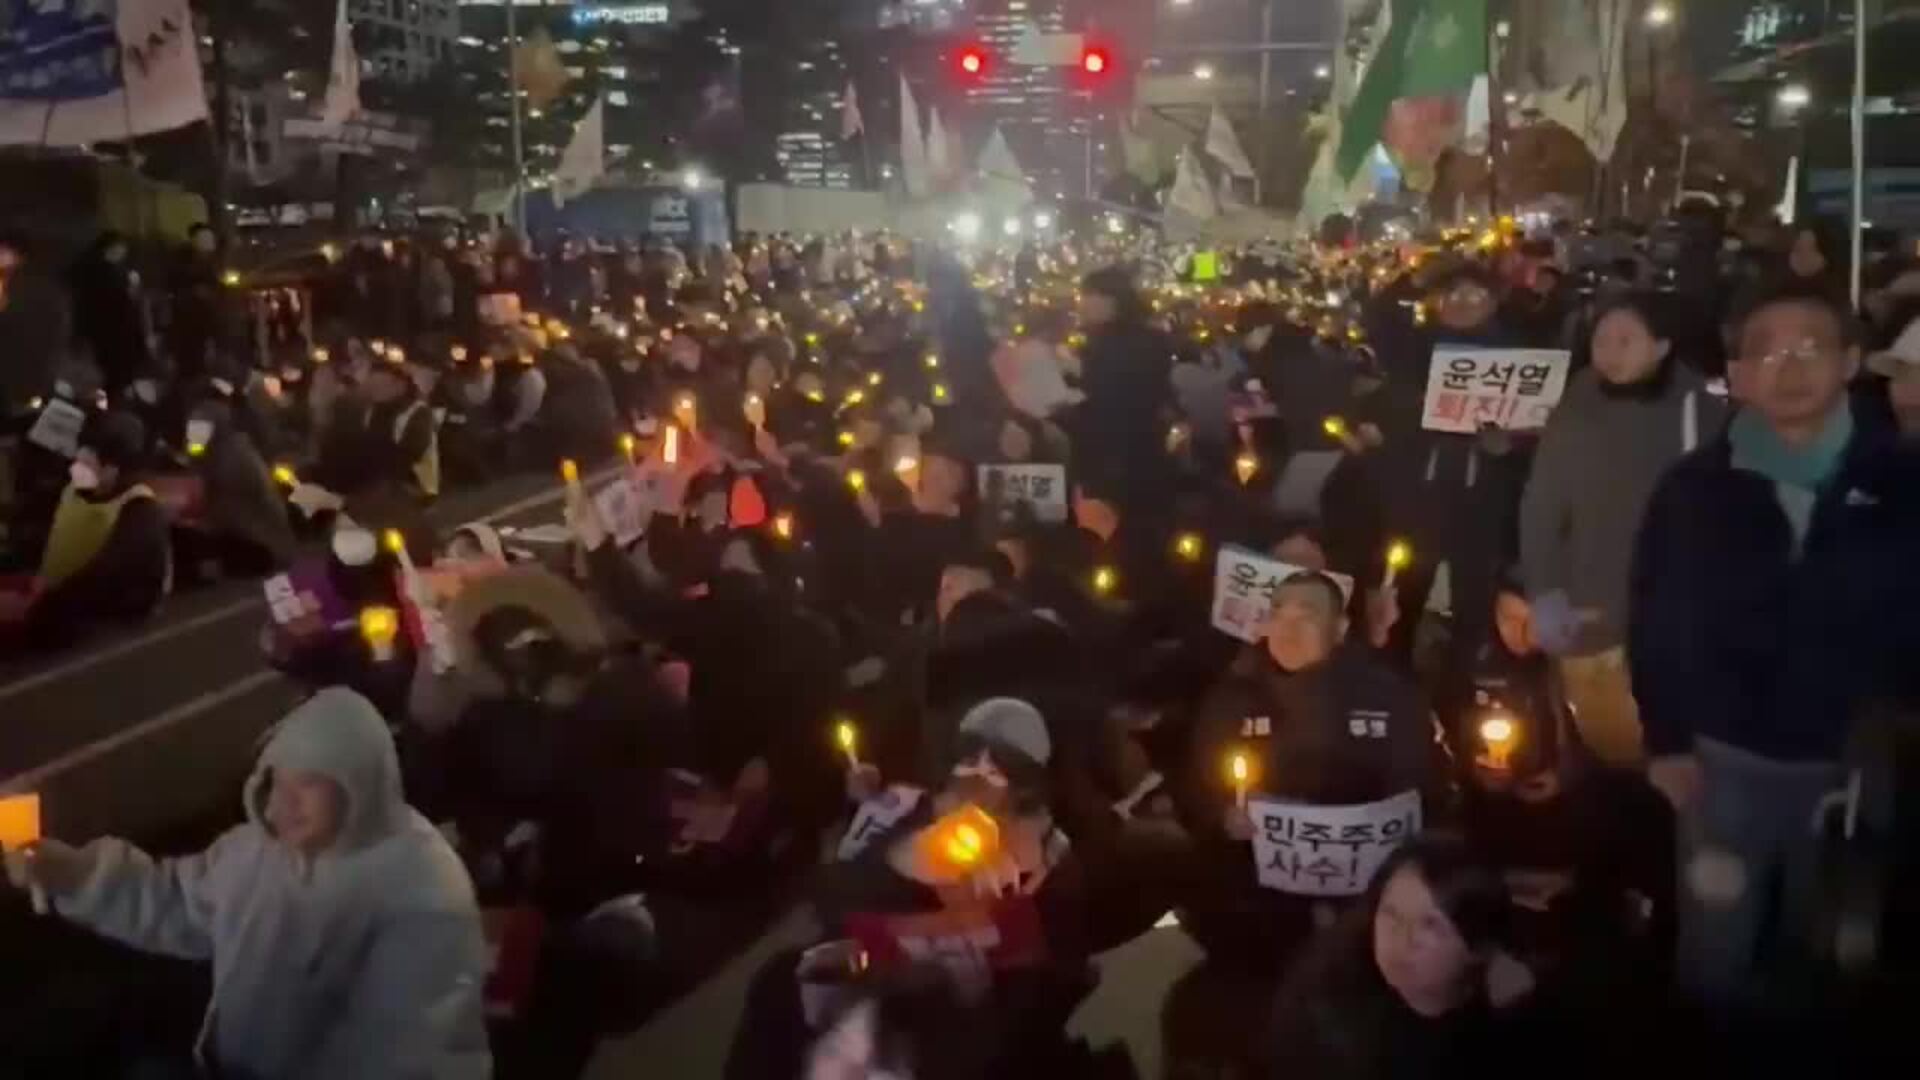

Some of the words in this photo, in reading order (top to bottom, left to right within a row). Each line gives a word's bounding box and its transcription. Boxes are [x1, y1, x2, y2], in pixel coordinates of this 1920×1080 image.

[1443, 358, 1550, 396] 윤석열
[1264, 811, 1414, 852] 민주주의
[1266, 850, 1356, 887] 사수!
